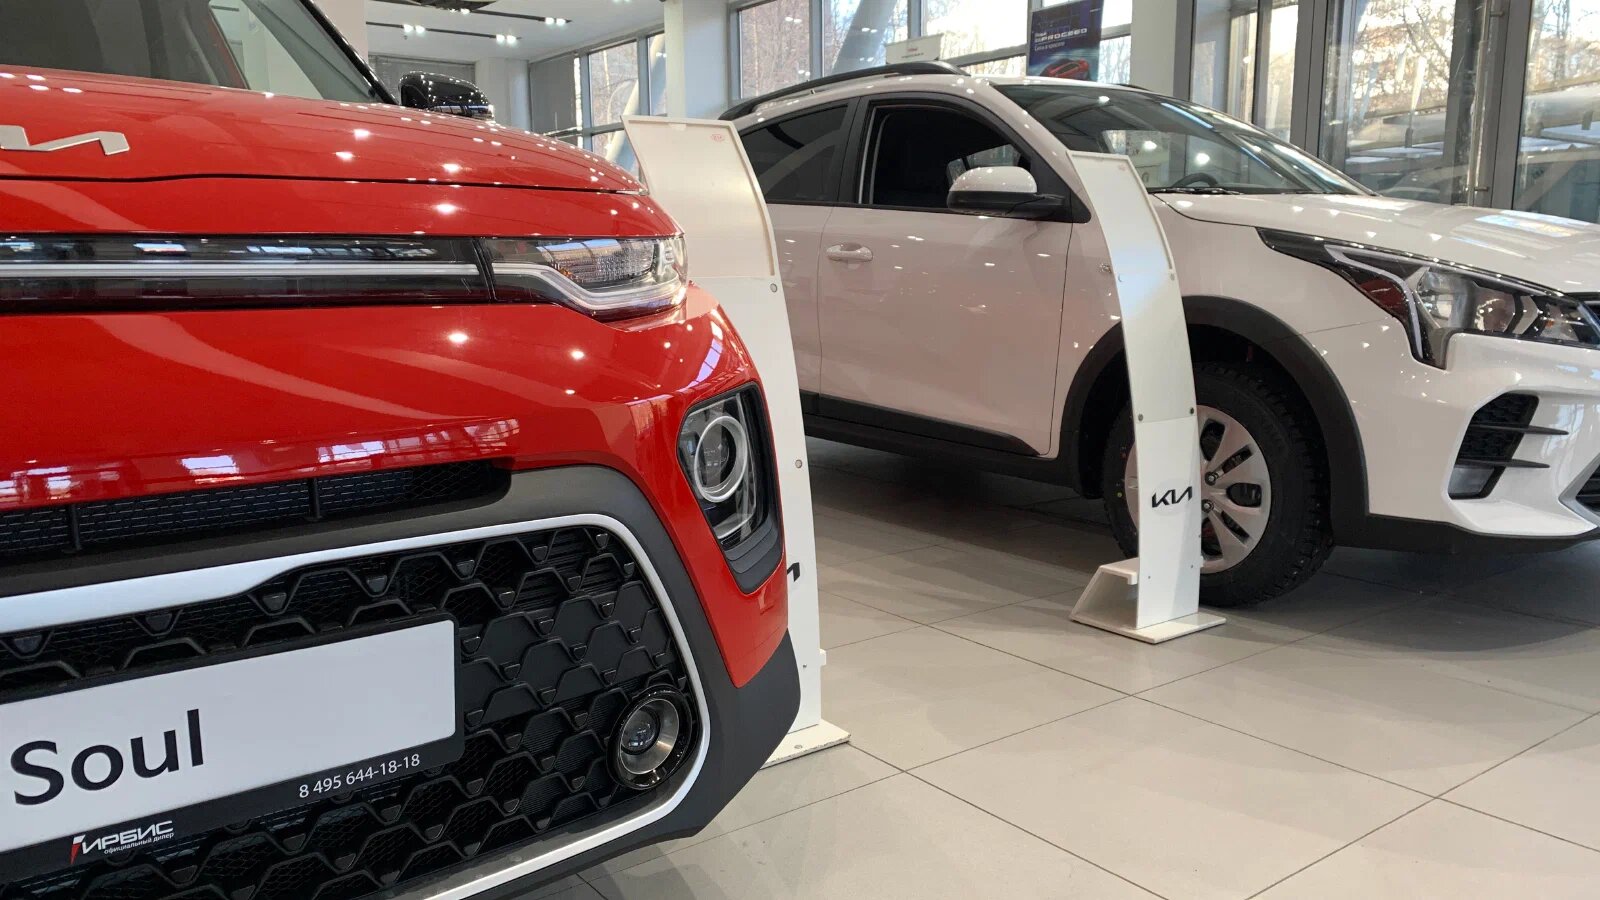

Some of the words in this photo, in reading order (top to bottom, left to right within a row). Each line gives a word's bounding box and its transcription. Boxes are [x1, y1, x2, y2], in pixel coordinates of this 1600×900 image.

[1151, 486, 1192, 508] KIA
[10, 708, 204, 805] Soul
[299, 784, 310, 798] 8
[313, 774, 342, 794] 495
[346, 753, 420, 785] 644-18-18
[82, 820, 174, 855] ИРБИС
[103, 837, 152, 855] официальный
[152, 832, 175, 843] дилер
